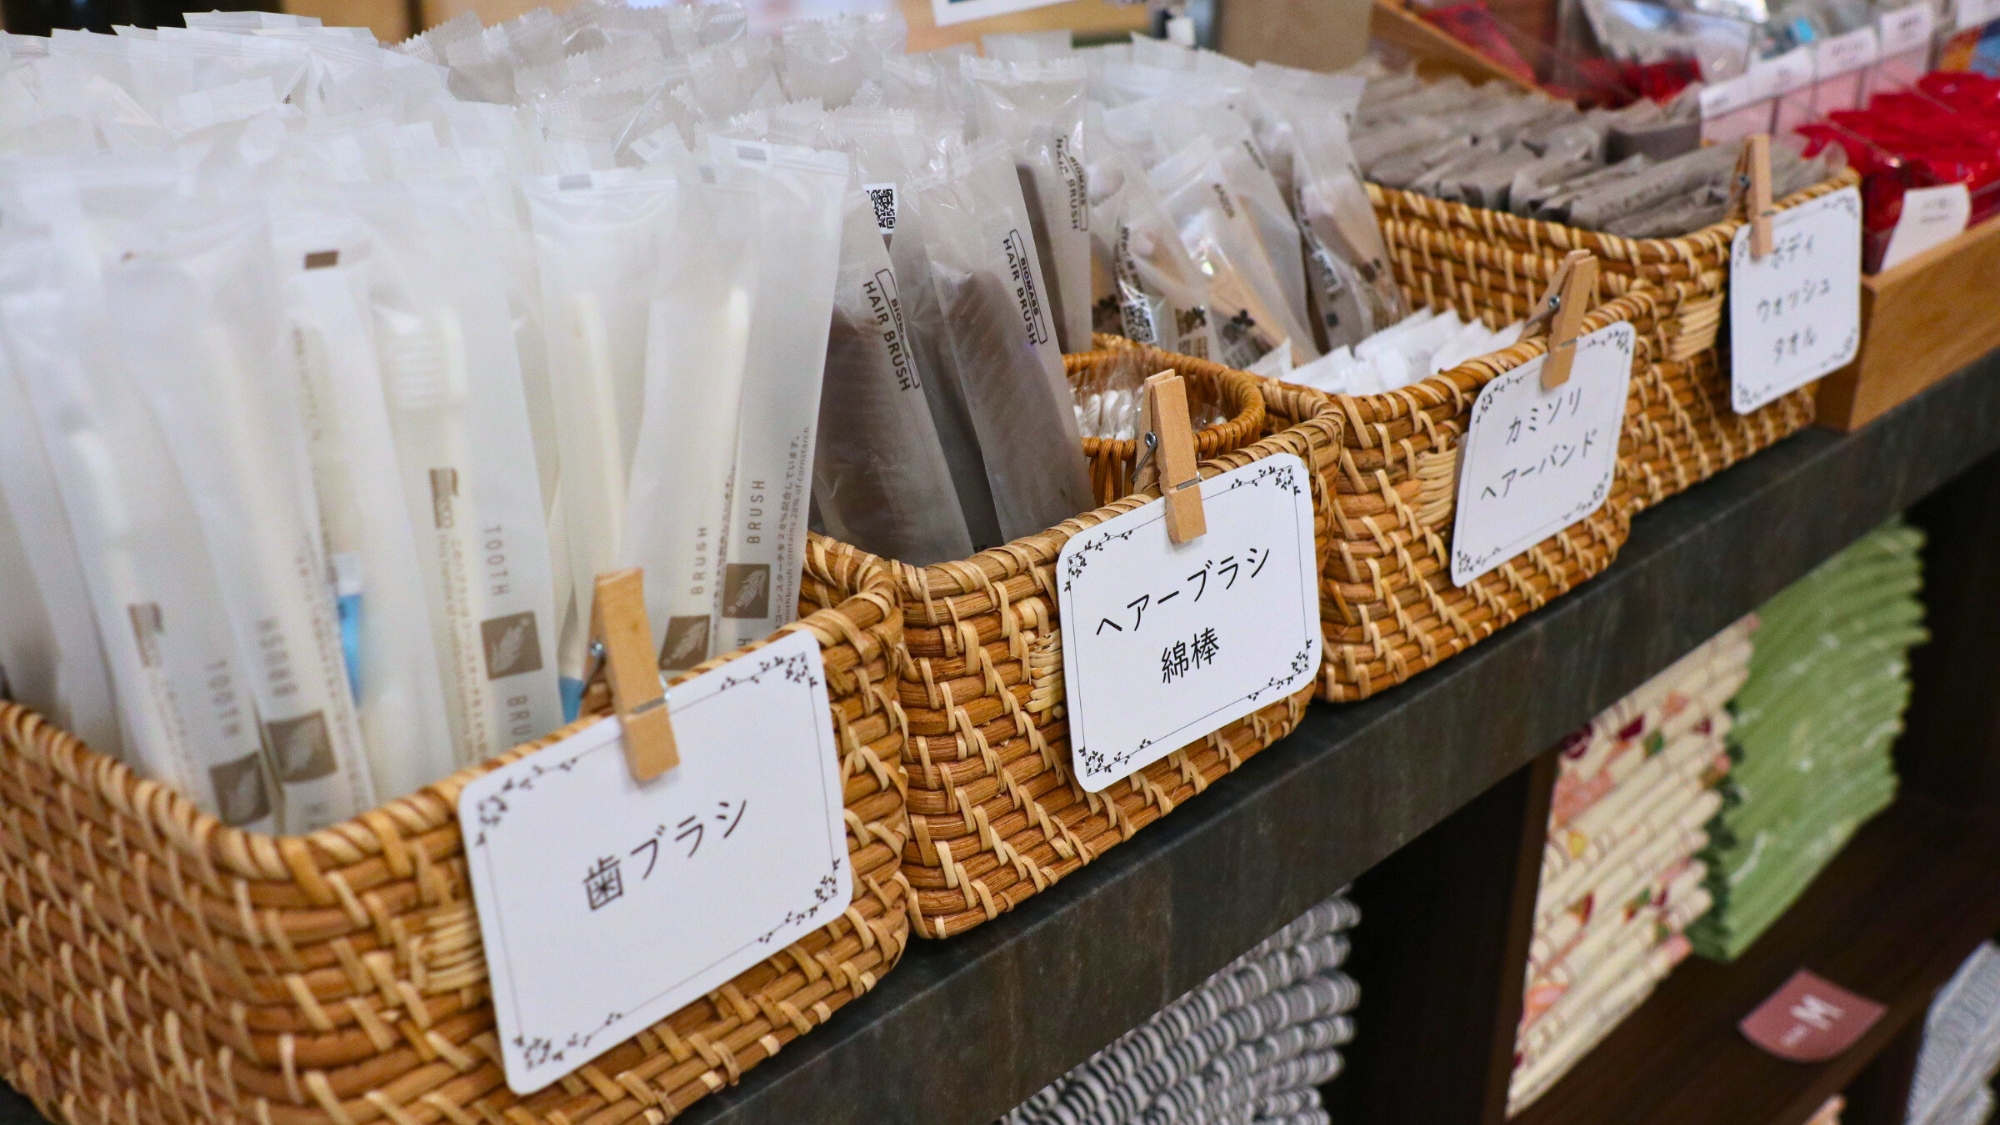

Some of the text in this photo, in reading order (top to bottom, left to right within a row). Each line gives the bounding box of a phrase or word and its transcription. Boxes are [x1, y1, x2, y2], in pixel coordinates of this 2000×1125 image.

[1002, 238, 1038, 346] HAIR BRUSH
[1020, 257, 1039, 316] BIOMASS
[1756, 276, 1831, 324] ウォッシュ
[862, 280, 911, 391] HAIR BRUSH
[1773, 326, 1817, 366] タオル
[1505, 387, 1582, 446] カミソリ
[1480, 428, 1598, 501] ヘアーバンド
[746, 480, 766, 544] BRUSH
[790, 498, 800, 520] 28%
[483, 526, 510, 597] TOOTH
[690, 526, 708, 596] BRUSH
[787, 521, 797, 566] contains
[785, 568, 793, 624] oothbrush
[1096, 547, 1270, 636] ヘアーブラシ
[1161, 627, 1220, 684] 綿棒
[506, 694, 533, 740] BRU
[583, 799, 747, 912] 歯ブラシ
